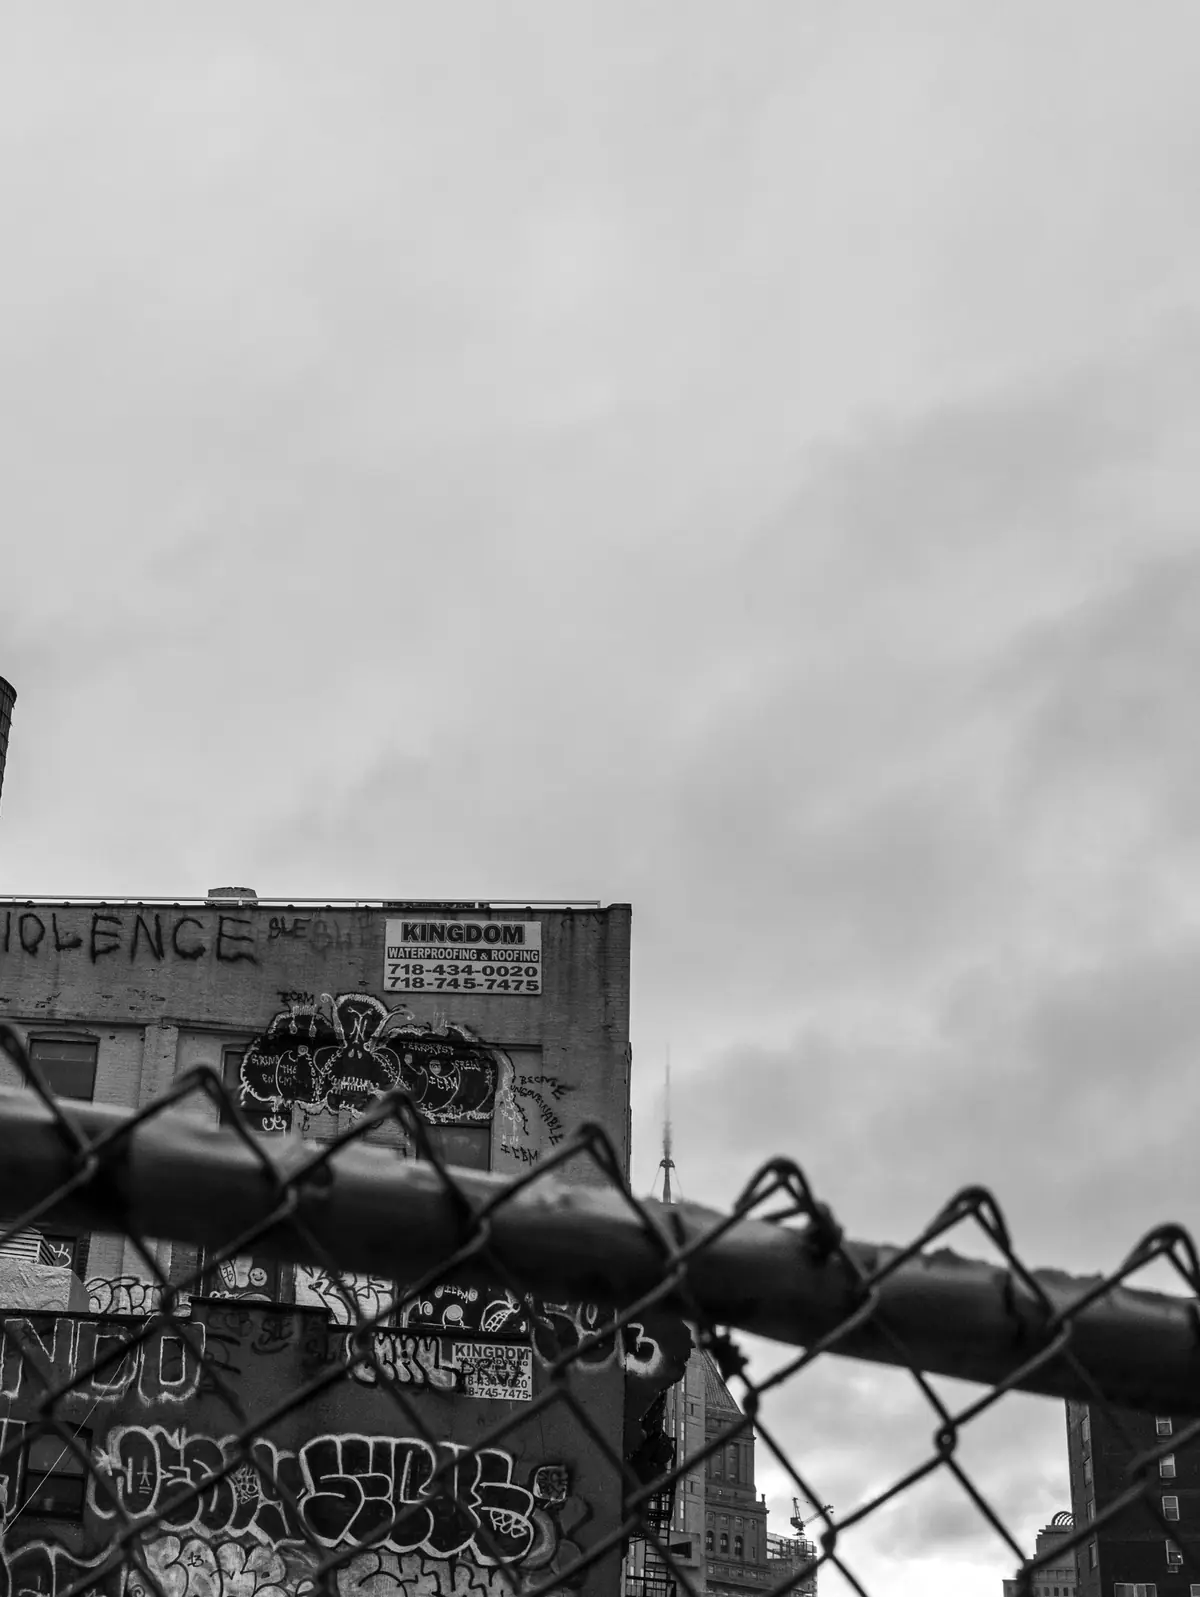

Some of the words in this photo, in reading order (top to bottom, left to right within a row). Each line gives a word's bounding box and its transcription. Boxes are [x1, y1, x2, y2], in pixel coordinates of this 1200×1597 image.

[401, 922, 525, 945] KINGDOM
[388, 947, 477, 961] WATERPROOFING
[480, 952, 488, 961] &
[491, 950, 539, 962] ROOFING
[388, 963, 538, 977] 718-434-0020
[388, 977, 539, 991] 718-745-7475
[455, 1345, 529, 1360] KINGDOM
[468, 1387, 529, 1399] 8-745-7475
